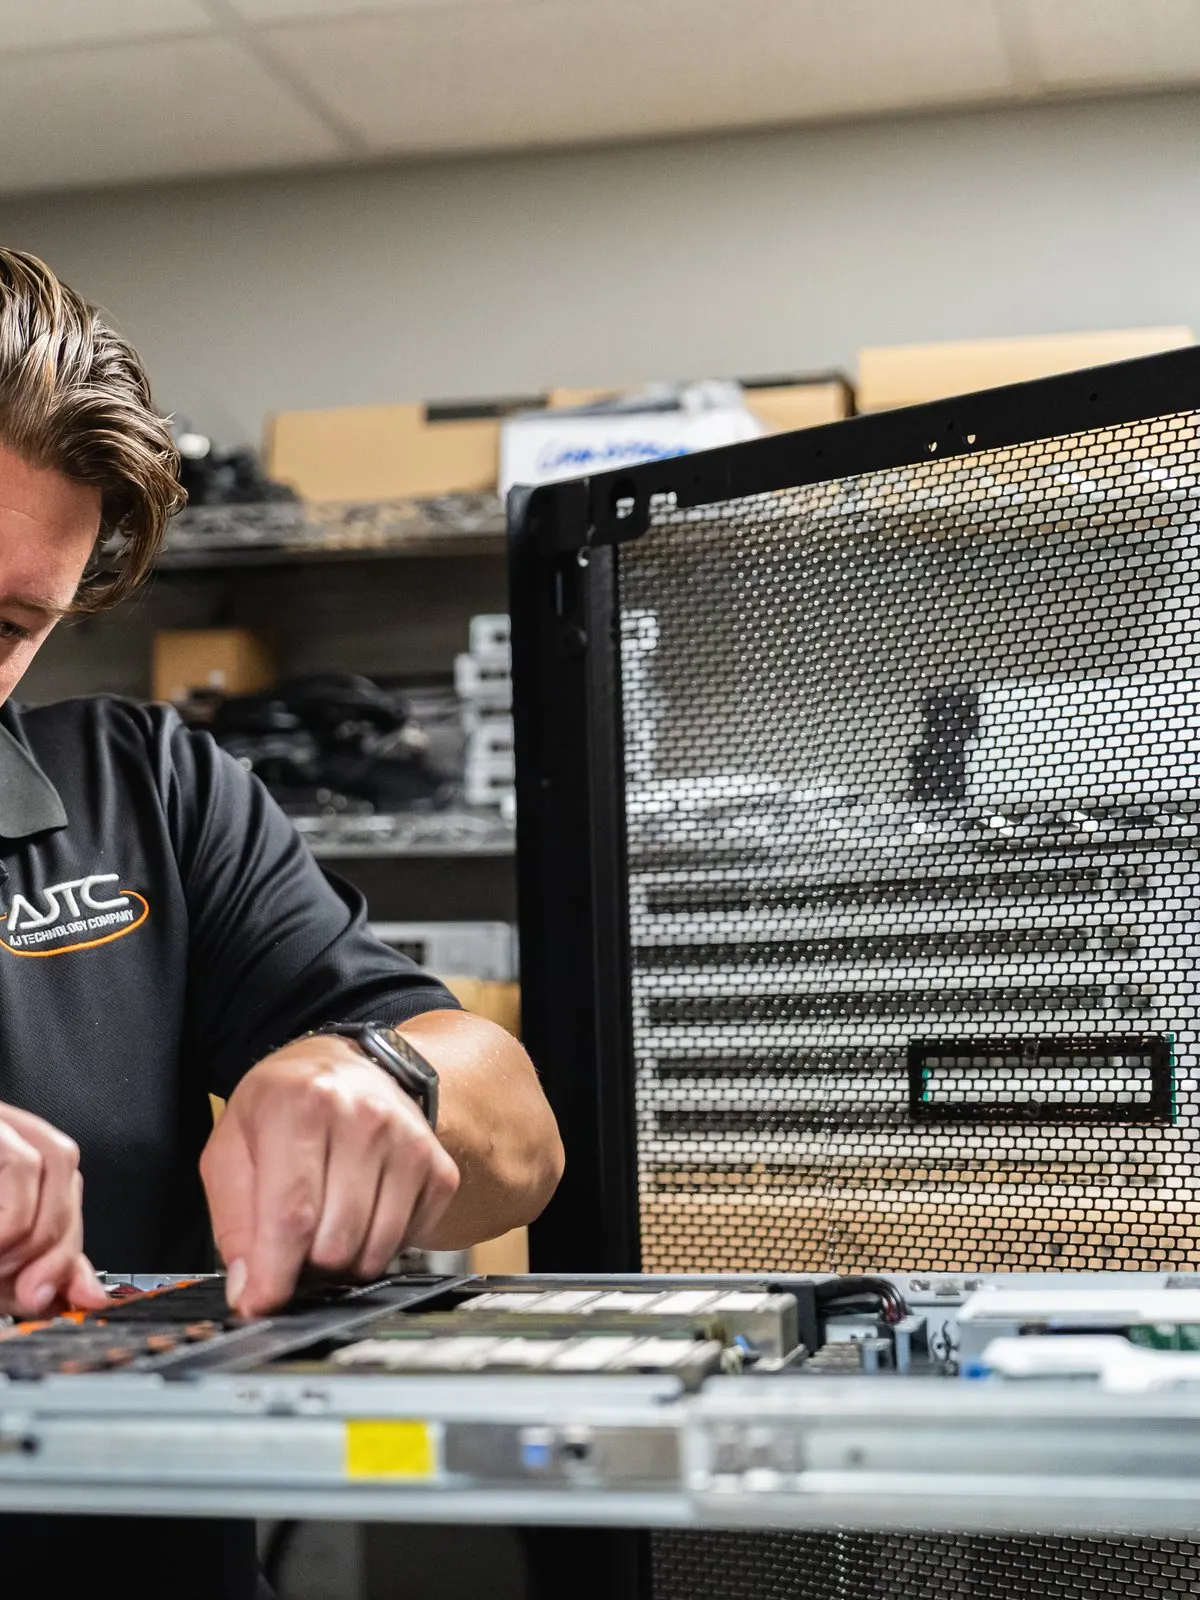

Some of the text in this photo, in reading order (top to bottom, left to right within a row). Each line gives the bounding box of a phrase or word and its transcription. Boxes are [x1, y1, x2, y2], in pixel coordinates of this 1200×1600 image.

[7, 873, 130, 931] AJTC
[22, 921, 88, 945] TECHNOLOGY
[88, 910, 134, 930] COMPANY
